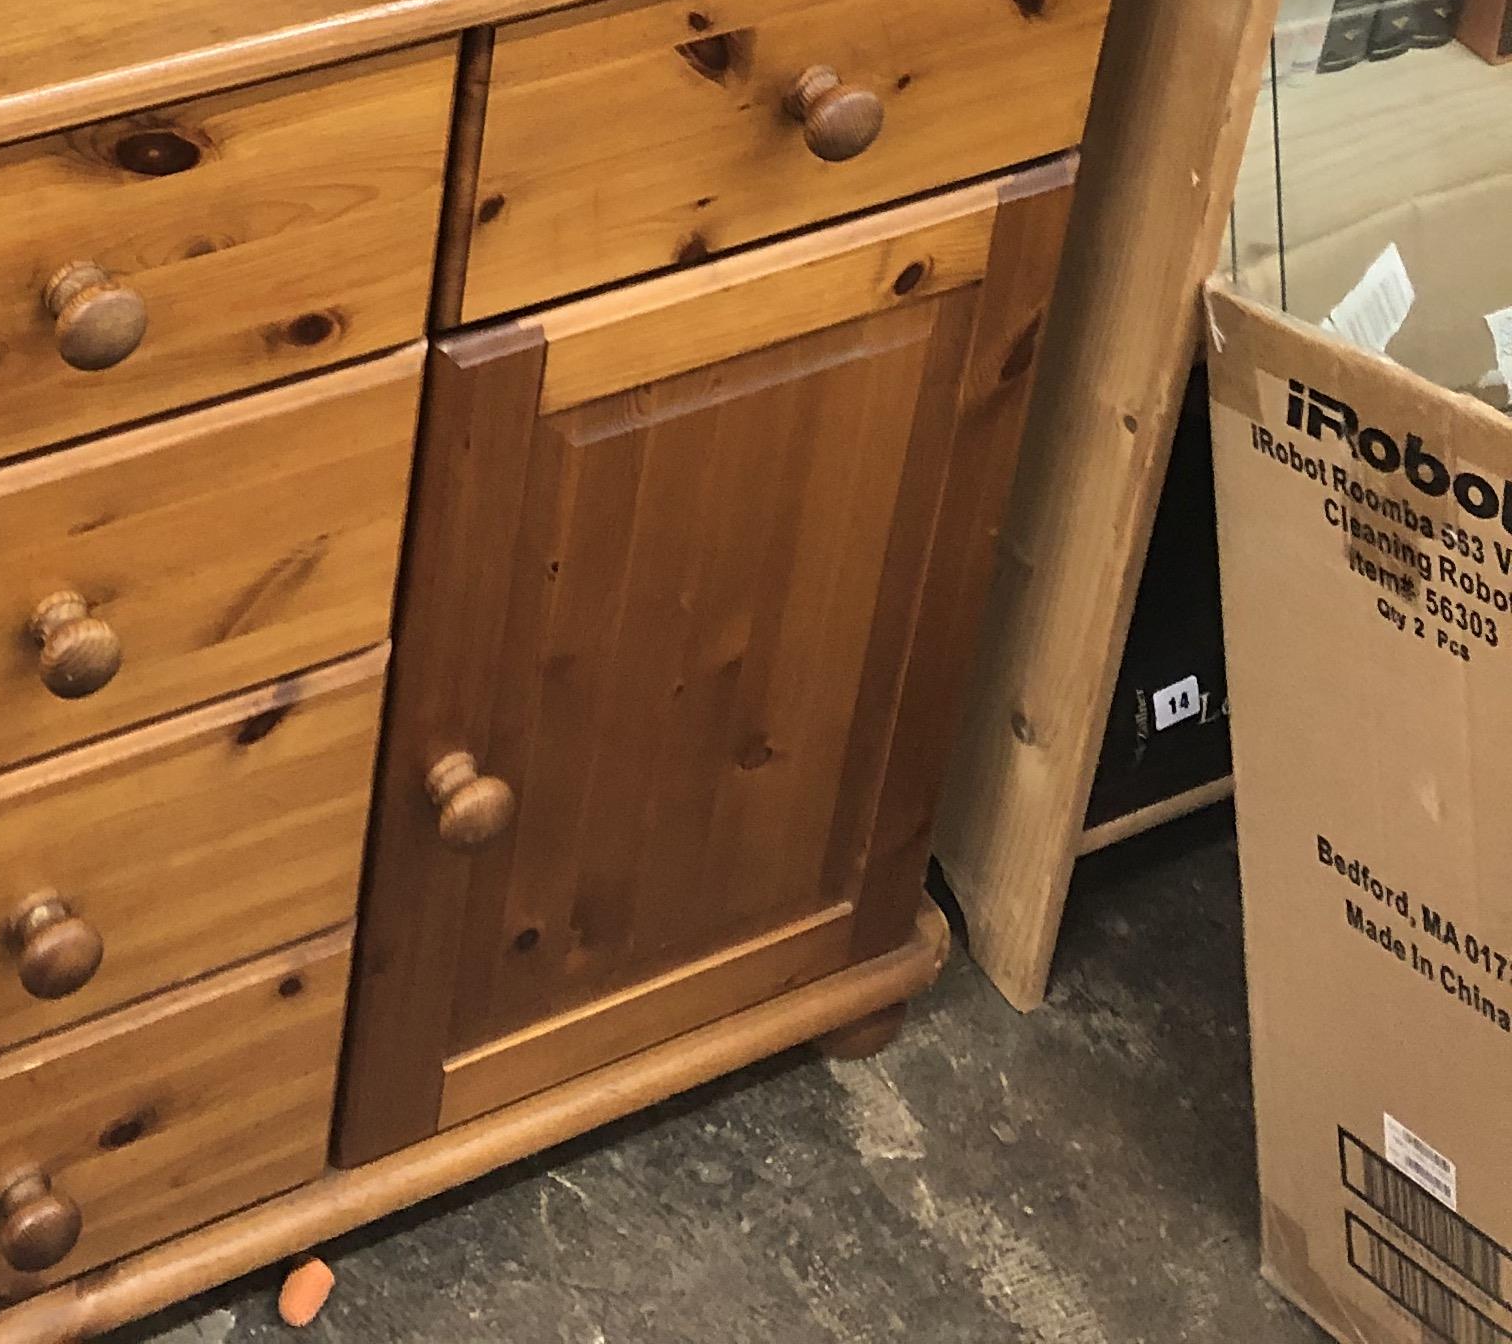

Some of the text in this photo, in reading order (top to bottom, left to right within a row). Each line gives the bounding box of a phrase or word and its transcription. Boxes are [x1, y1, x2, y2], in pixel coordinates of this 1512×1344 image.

[1250, 421, 1328, 487] iRobot
[1331, 464, 1435, 540] Roomba
[1441, 522, 1485, 564] 563
[1324, 498, 1512, 613] Cleaning Robo
[1349, 549, 1499, 648] Item# 56303
[1377, 597, 1472, 663] Qty 2 Pcs
[1168, 691, 1190, 715] 14
[1316, 834, 1512, 984] Bedford, MA 017
[1345, 898, 1407, 961] Made
[1440, 963, 1511, 1033] China
